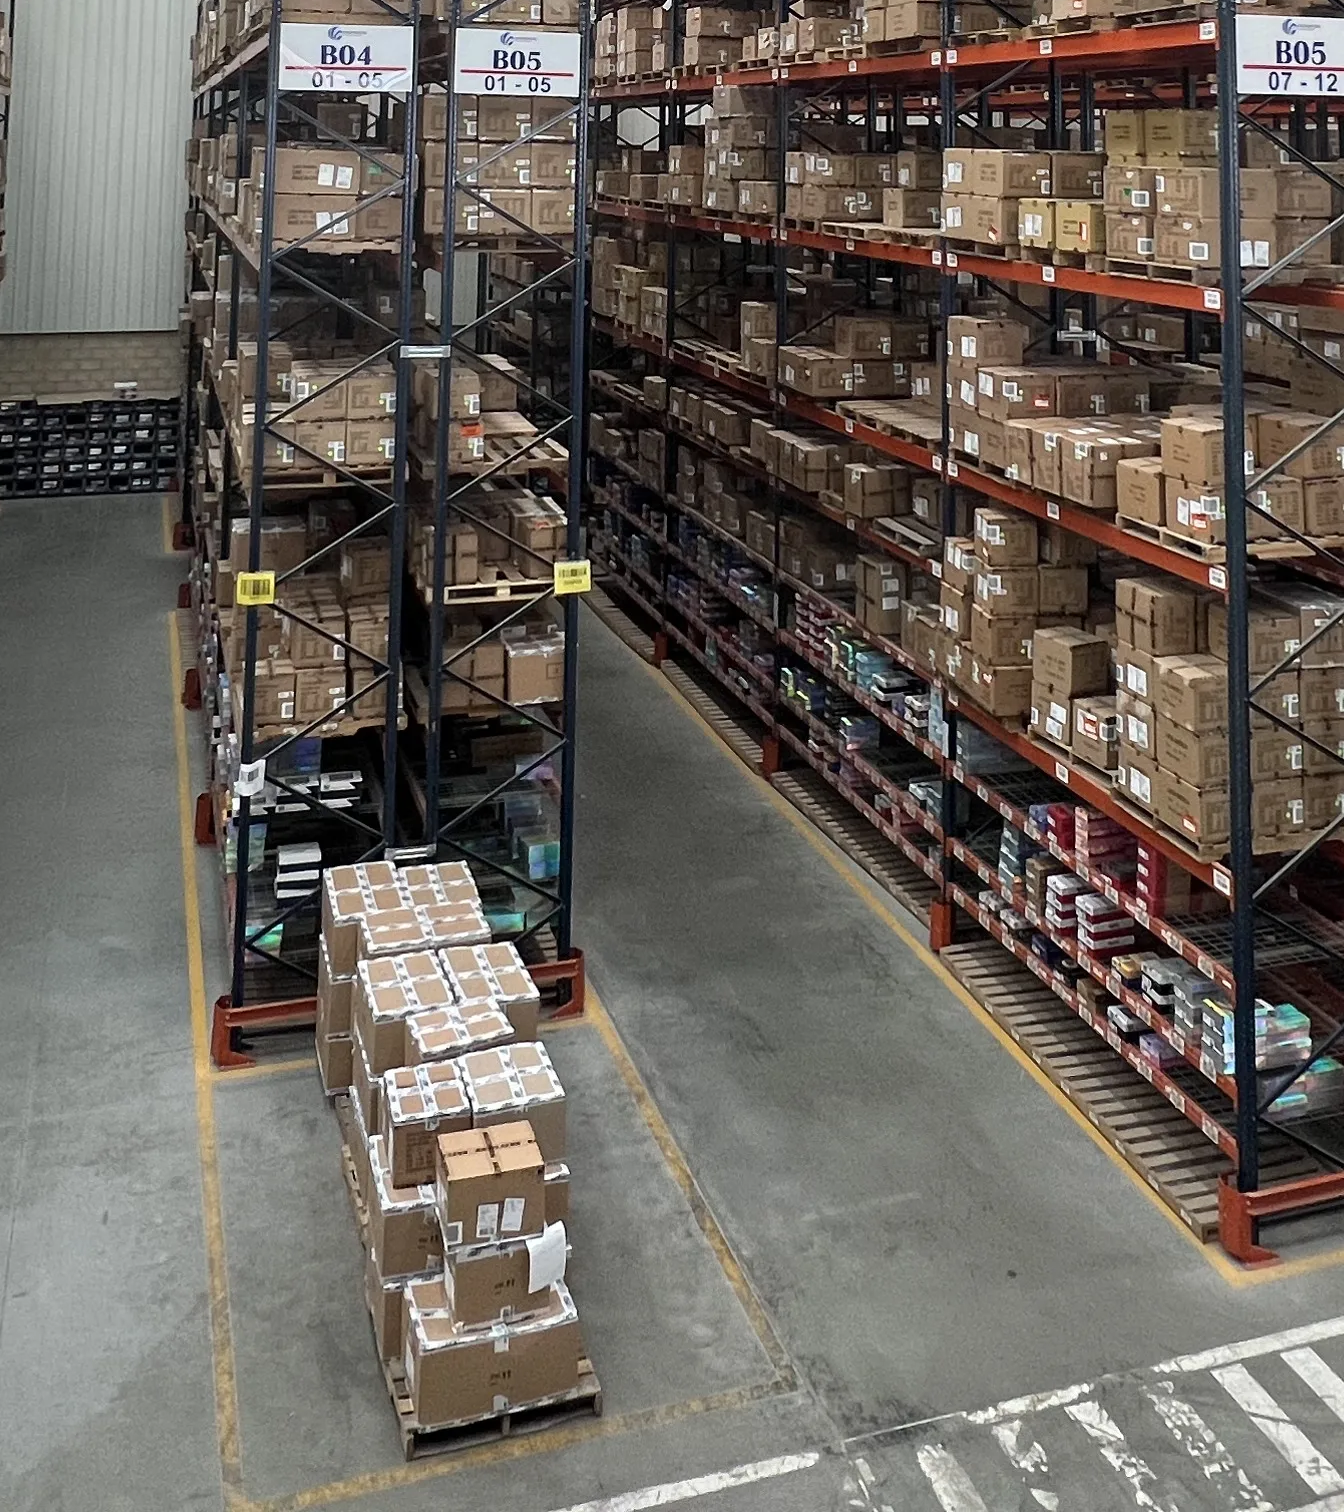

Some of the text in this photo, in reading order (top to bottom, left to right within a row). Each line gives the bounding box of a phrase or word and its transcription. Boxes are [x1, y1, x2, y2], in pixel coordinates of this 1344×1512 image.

[320, 44, 372, 66] B04
[492, 49, 542, 71] B05
[1275, 40, 1327, 66] B05
[311, 71, 335, 88] 01
[358, 71, 383, 89] 05
[484, 74, 506, 92] 01
[528, 76, 551, 93] 05
[1268, 71, 1293, 91] 07
[1314, 72, 1339, 92] 12
